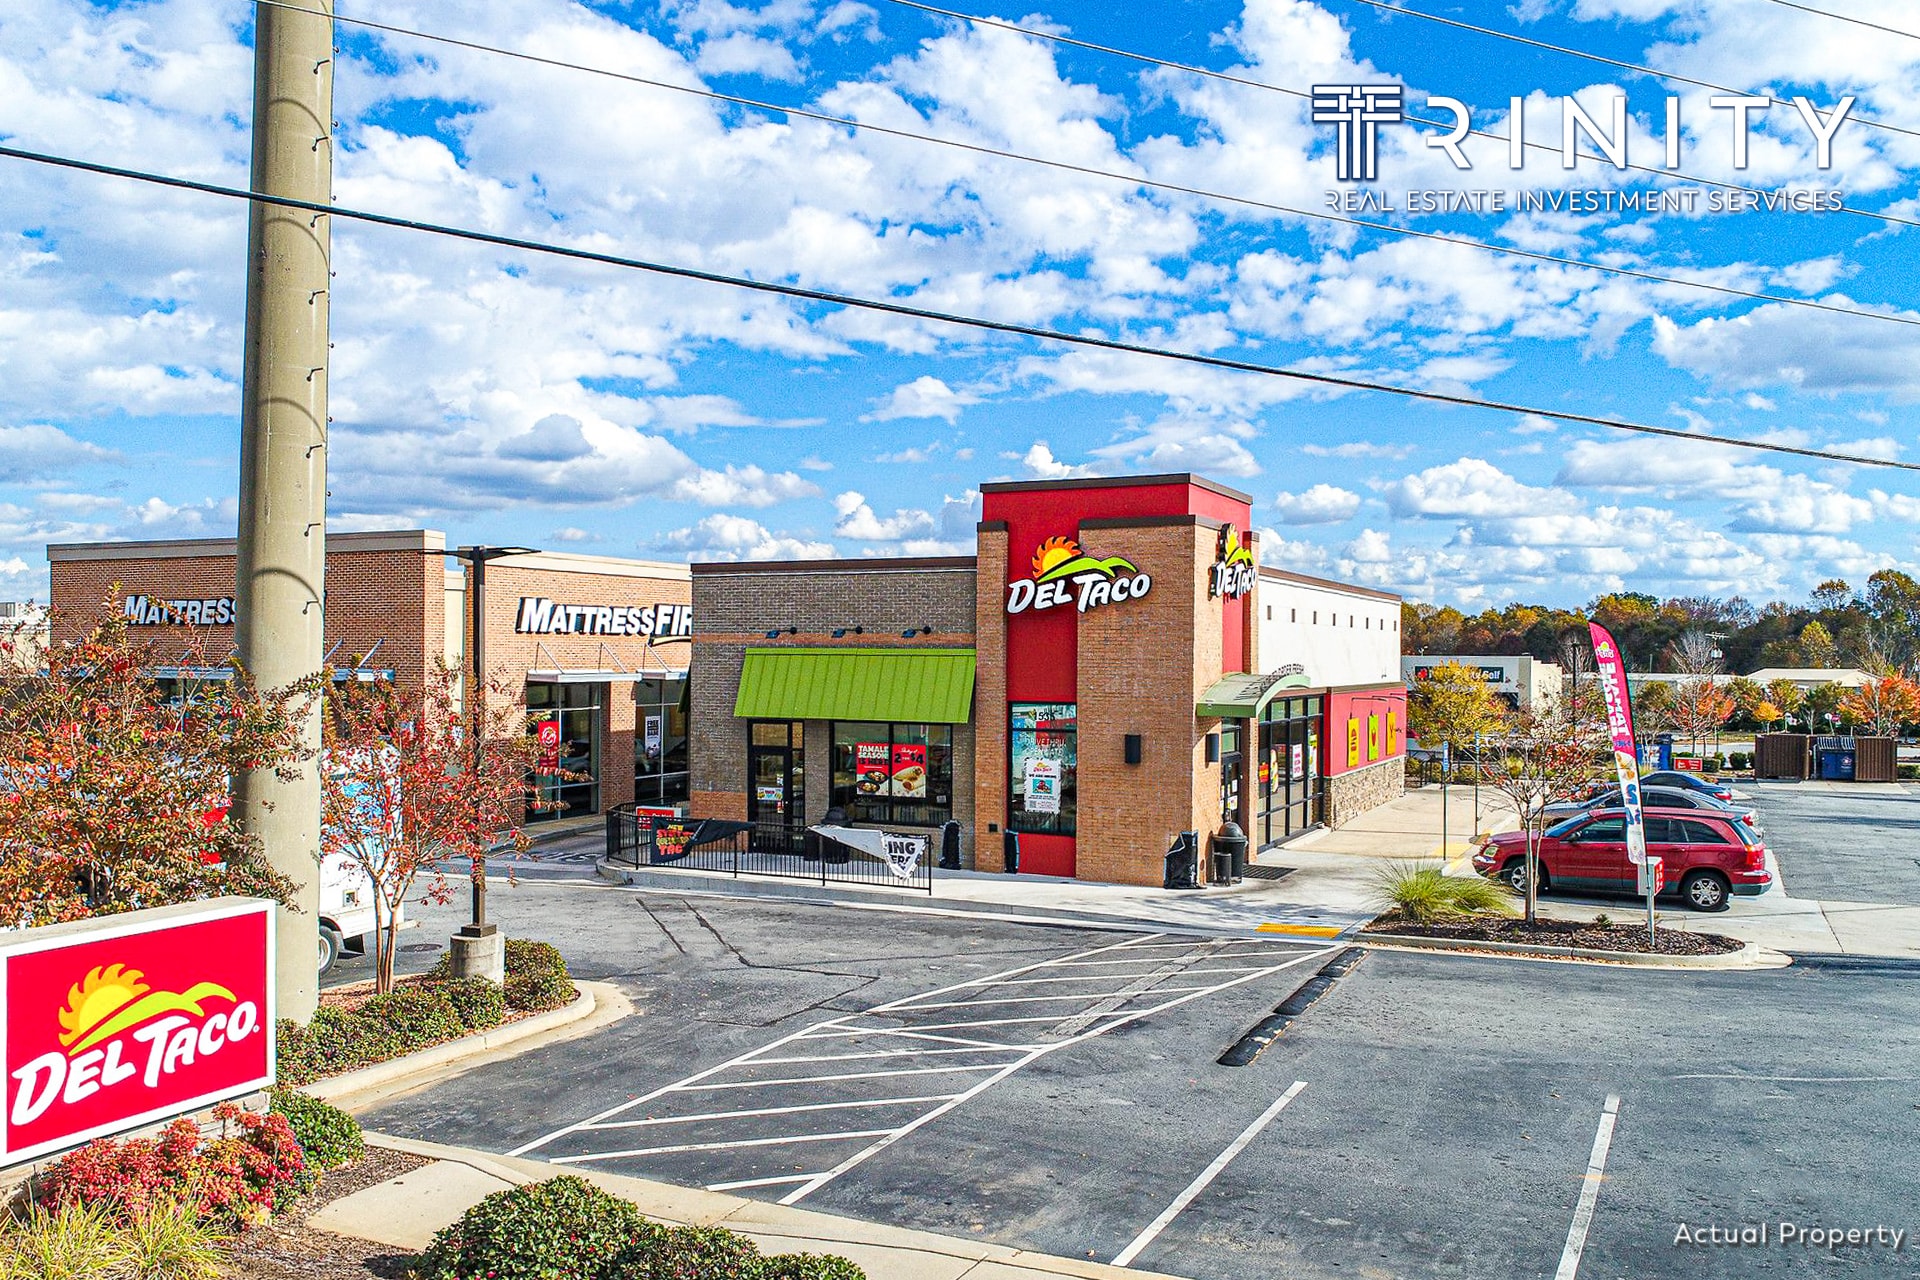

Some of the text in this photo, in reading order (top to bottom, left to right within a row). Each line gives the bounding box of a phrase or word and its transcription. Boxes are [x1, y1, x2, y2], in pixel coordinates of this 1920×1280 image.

[1007, 573, 1152, 614] DEL TACO
[1214, 561, 1258, 600] DEL TACO
[888, 841, 916, 855] ING
[10, 1000, 260, 1127] DEL TACO
